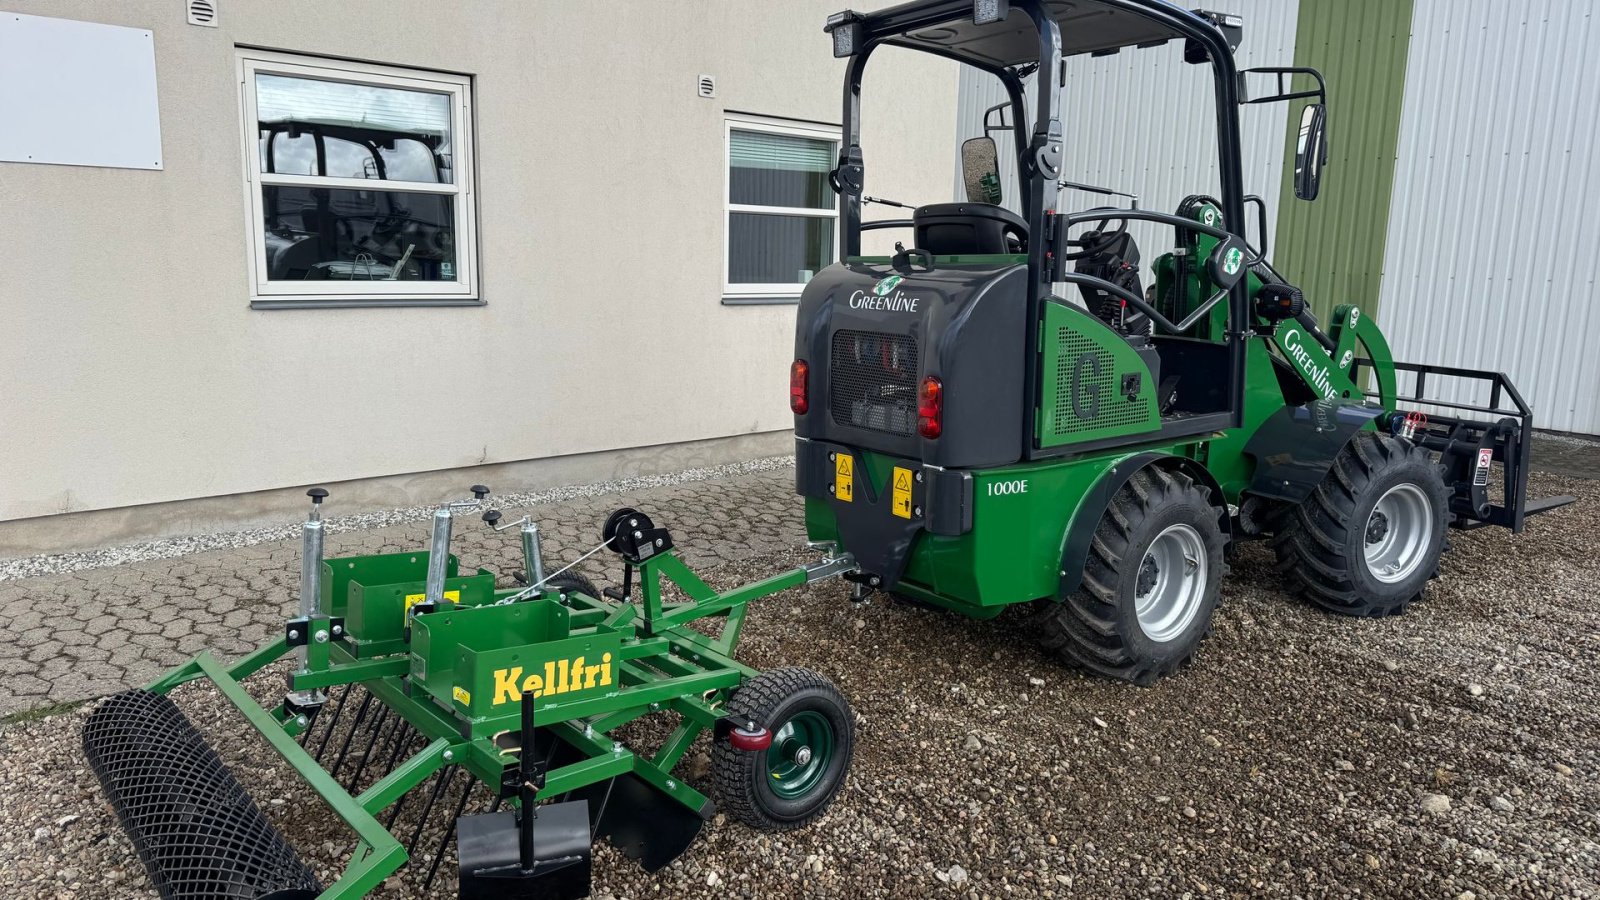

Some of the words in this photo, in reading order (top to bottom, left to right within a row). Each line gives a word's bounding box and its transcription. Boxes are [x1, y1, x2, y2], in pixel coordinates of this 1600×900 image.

[1072, 352, 1100, 419] G
[987, 480, 1028, 496] 1000E
[492, 652, 611, 705] Kellfri
